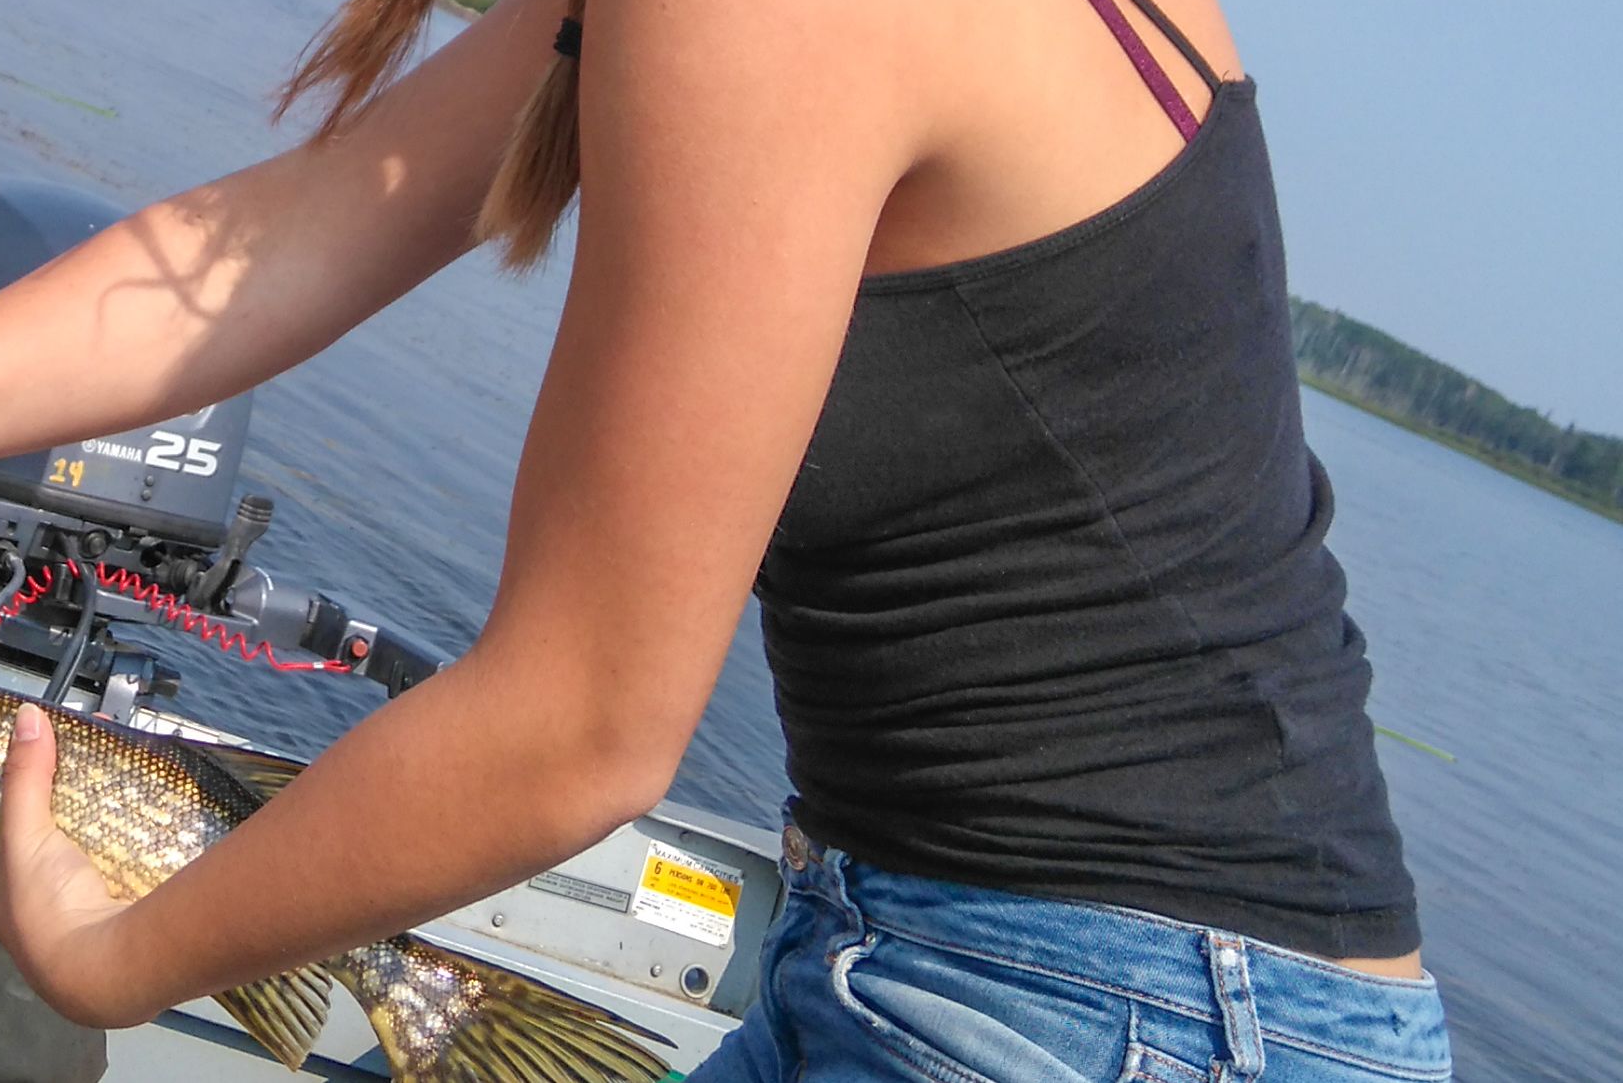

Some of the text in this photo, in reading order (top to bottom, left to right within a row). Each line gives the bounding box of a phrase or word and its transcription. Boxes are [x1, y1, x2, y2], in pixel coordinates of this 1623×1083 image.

[97, 430, 222, 477] YAMAHA 25
[654, 861, 663, 875] 6
[694, 862, 740, 884] CAPACITIES
